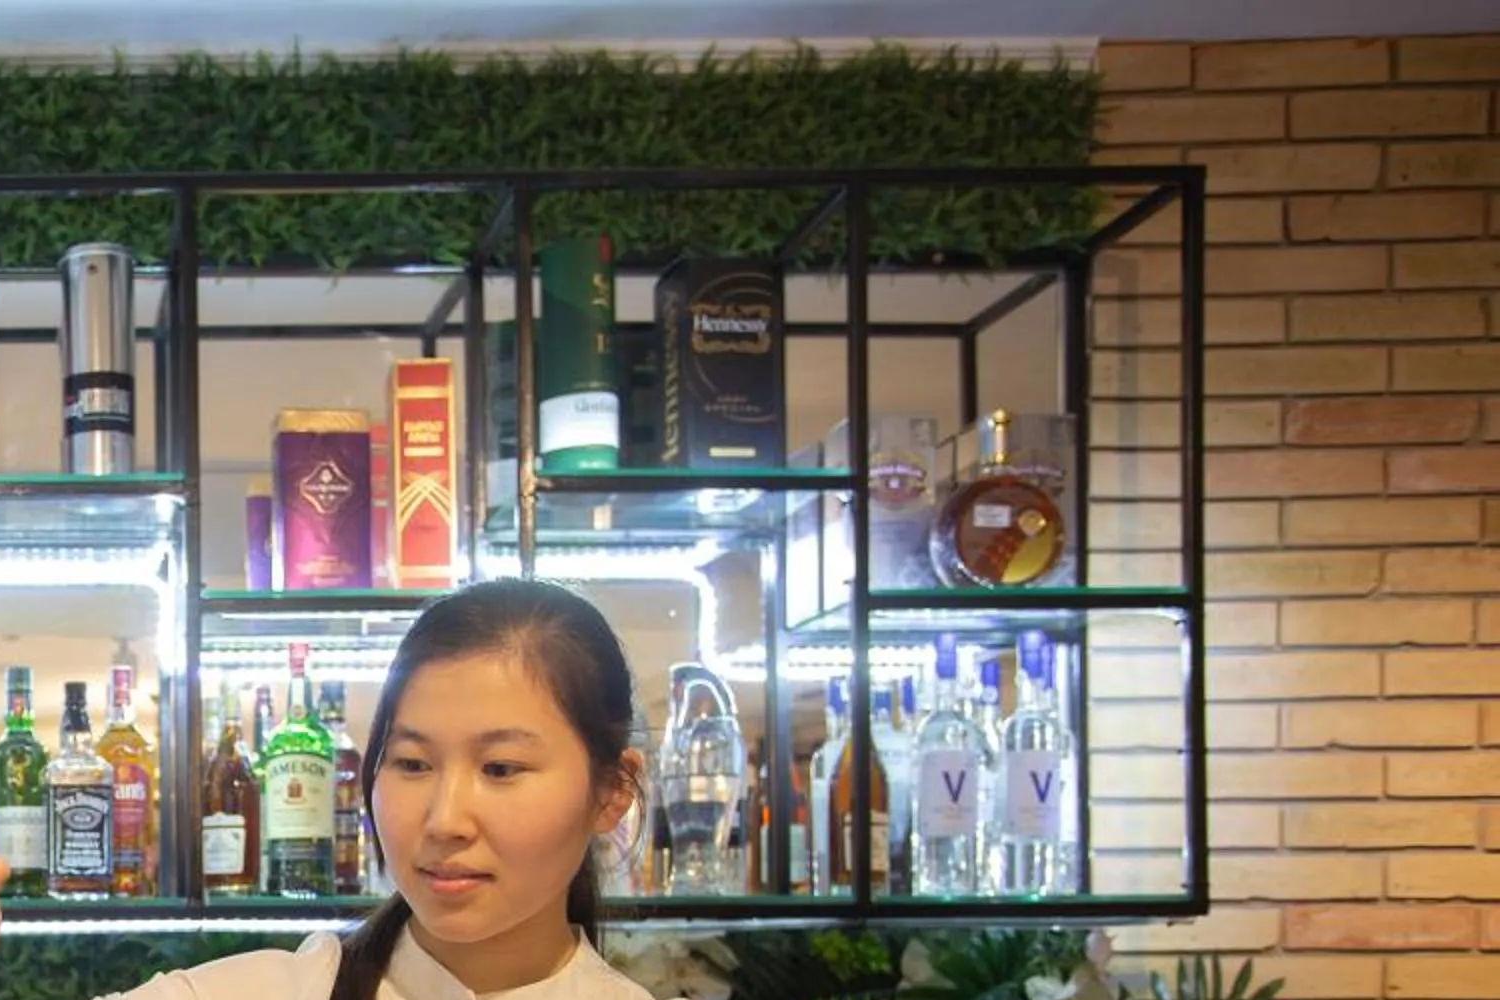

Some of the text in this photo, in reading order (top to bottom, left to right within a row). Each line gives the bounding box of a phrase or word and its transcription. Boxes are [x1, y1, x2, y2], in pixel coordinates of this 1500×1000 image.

[693, 314, 768, 332] Hennessy
[942, 770, 966, 803] V
[1030, 770, 1052, 803] V
